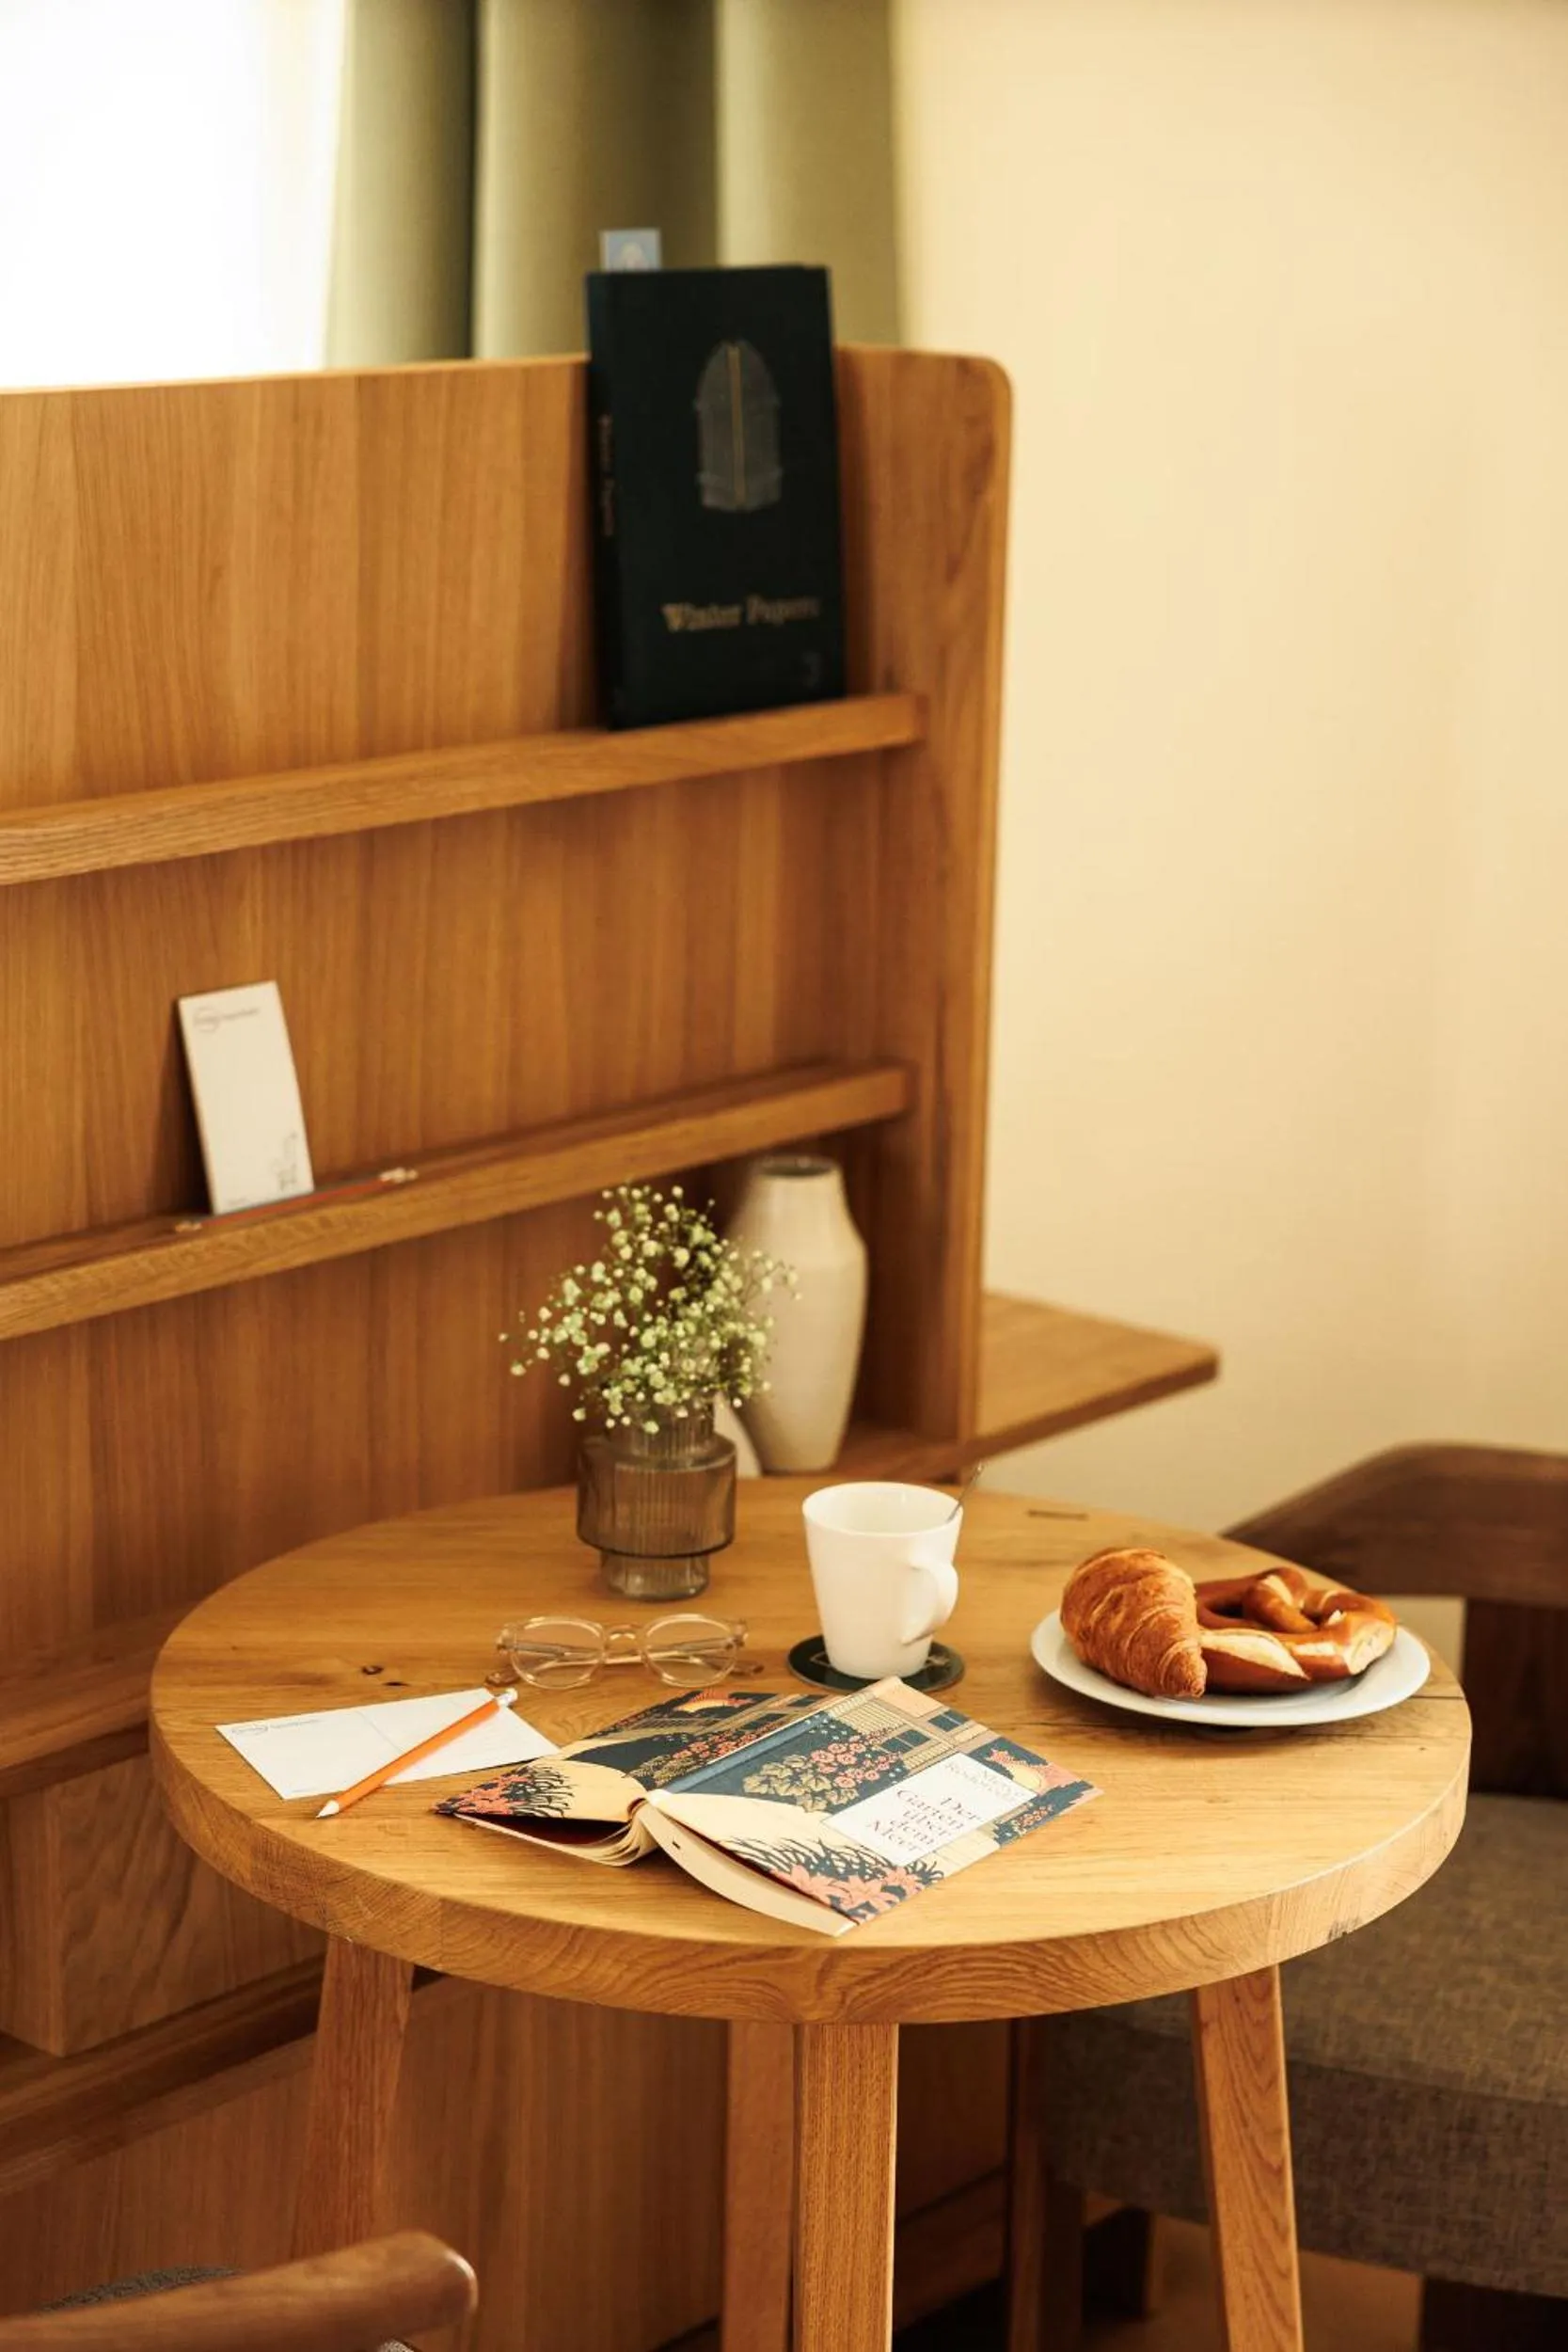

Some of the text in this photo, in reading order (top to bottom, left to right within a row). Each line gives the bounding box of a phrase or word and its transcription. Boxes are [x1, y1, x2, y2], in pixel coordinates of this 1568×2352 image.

[897, 1789, 965, 1830] Garten
[941, 1796, 982, 1822] Der
[868, 1820, 924, 1851] Meer
[889, 1820, 936, 1846] dem
